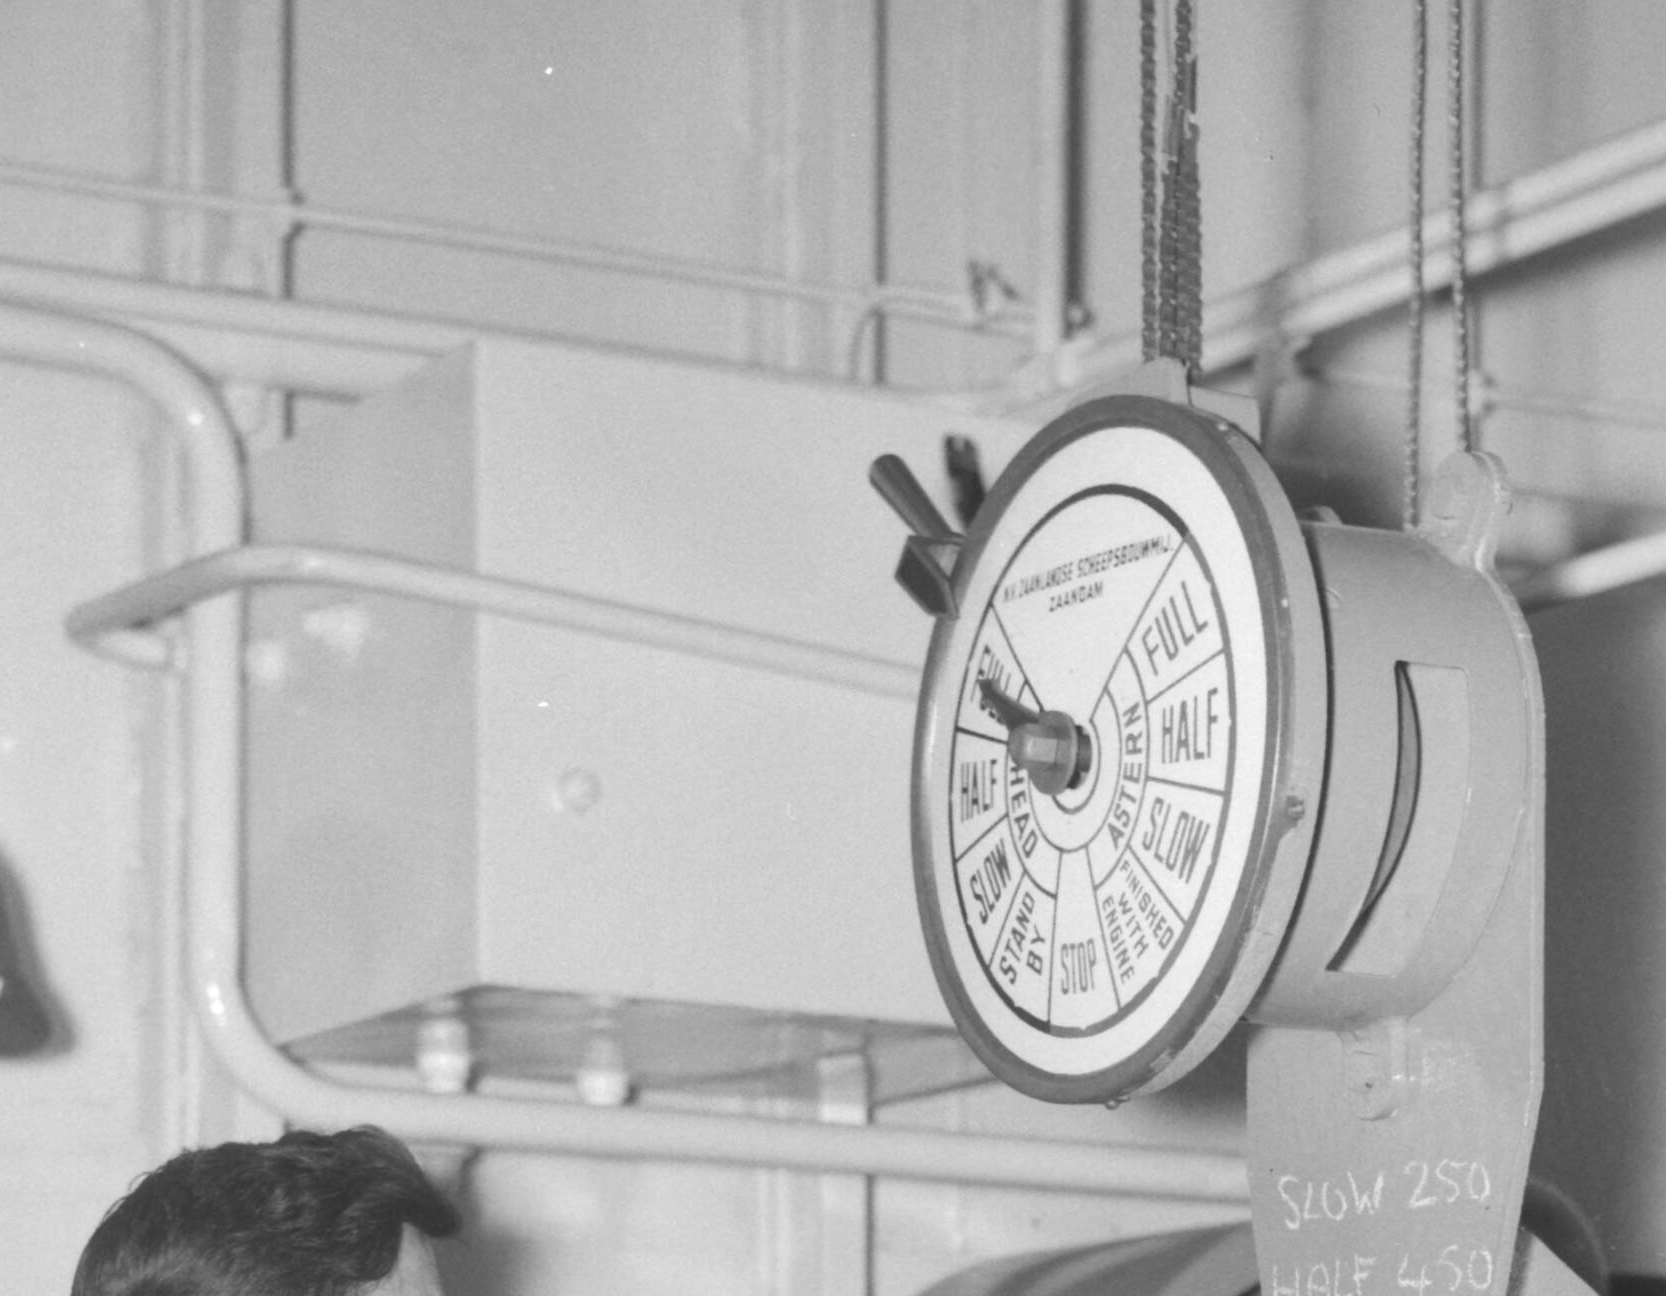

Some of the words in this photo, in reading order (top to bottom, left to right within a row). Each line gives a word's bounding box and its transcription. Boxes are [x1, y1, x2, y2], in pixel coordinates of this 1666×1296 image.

[1048, 581, 1104, 612] ZAANDAM
[1141, 580, 1208, 676] FULL
[1162, 687, 1218, 764] HALF
[961, 758, 997, 823] HALF
[1010, 766, 1038, 859] HEAD
[1107, 701, 1143, 850] ASTERN
[970, 837, 1011, 925] SLOW
[1143, 797, 1210, 884] SLOW
[999, 891, 1035, 985] STAND
[1102, 895, 1135, 984] ENGINE
[1118, 893, 1149, 959] WITH
[1119, 860, 1175, 950] FINISHED
[1026, 924, 1045, 976] BY
[1061, 937, 1097, 995] STOP
[1277, 1171, 1384, 1230] SLOW
[1403, 1158, 1491, 1209] 250
